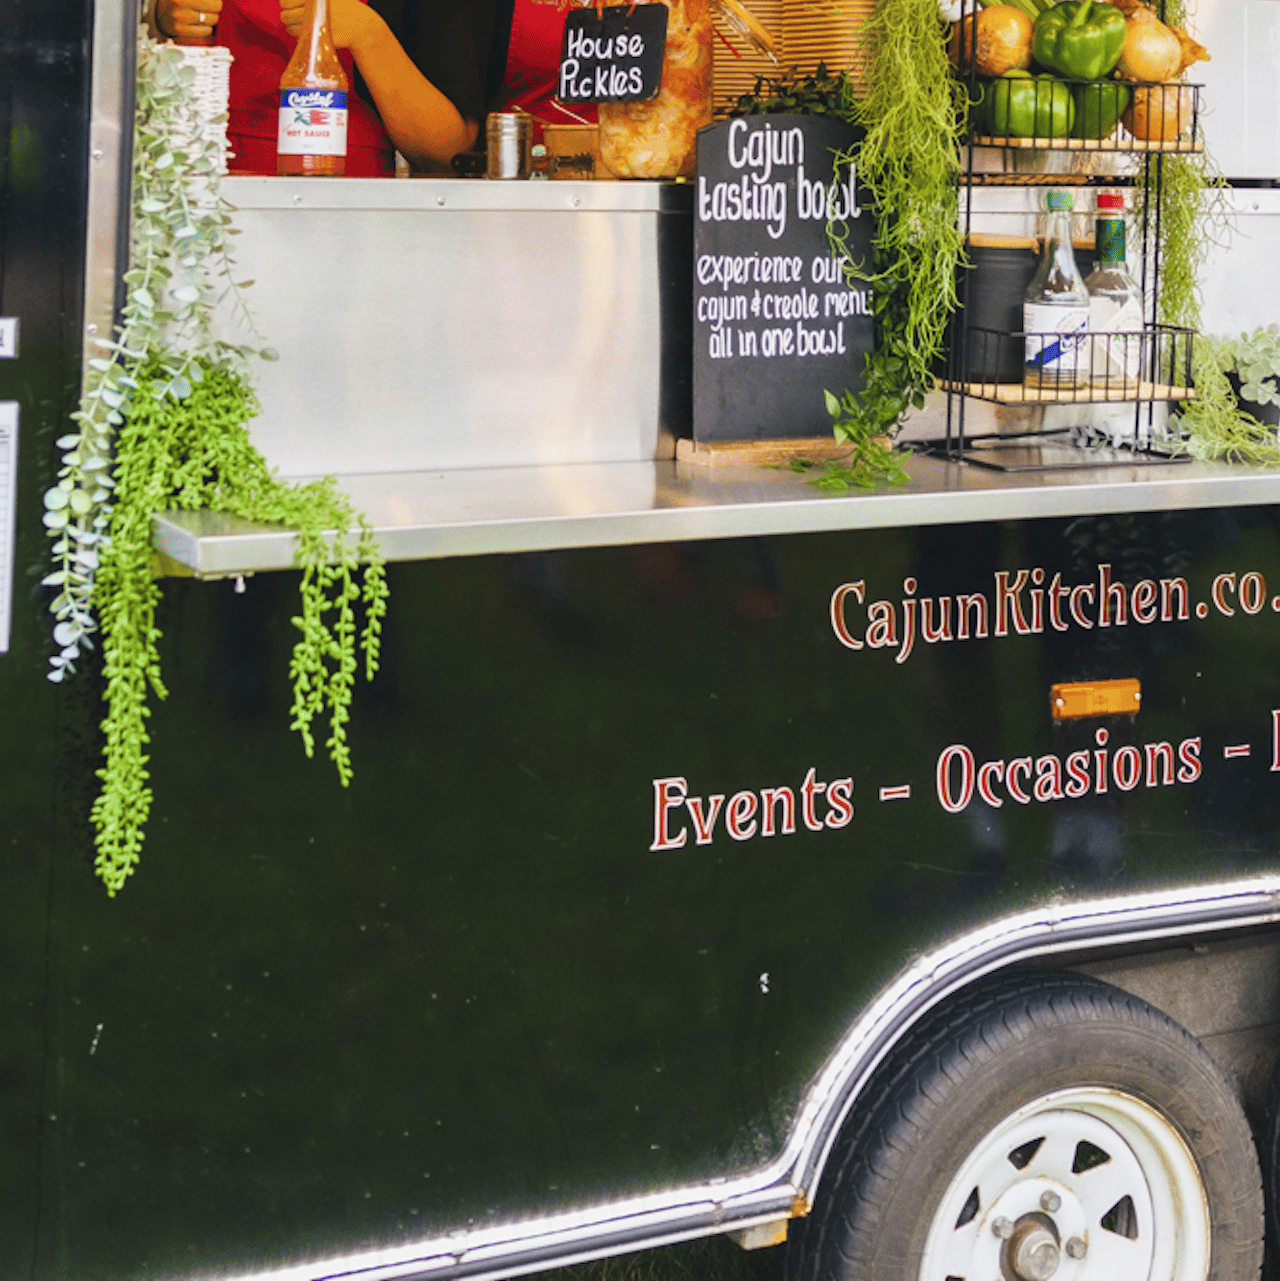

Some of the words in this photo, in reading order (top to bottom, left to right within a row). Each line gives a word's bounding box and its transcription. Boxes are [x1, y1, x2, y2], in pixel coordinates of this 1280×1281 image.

[568, 28, 644, 60] House
[560, 59, 643, 100] Pickles
[728, 119, 804, 185] Cajun
[699, 175, 787, 239] tasting
[797, 165, 861, 220] bowl
[697, 251, 803, 291] experience
[811, 255, 849, 284] our
[698, 290, 747, 332] cajun
[751, 289, 761, 317] &
[763, 286, 818, 320] creole
[708, 327, 733, 359] all
[739, 330, 757, 356] in
[762, 327, 795, 356] one
[797, 321, 846, 357] bowl
[650, 768, 854, 852] Events
[879, 784, 911, 801] -
[935, 729, 1202, 813] Occasions
[1224, 743, 1251, 760] -
